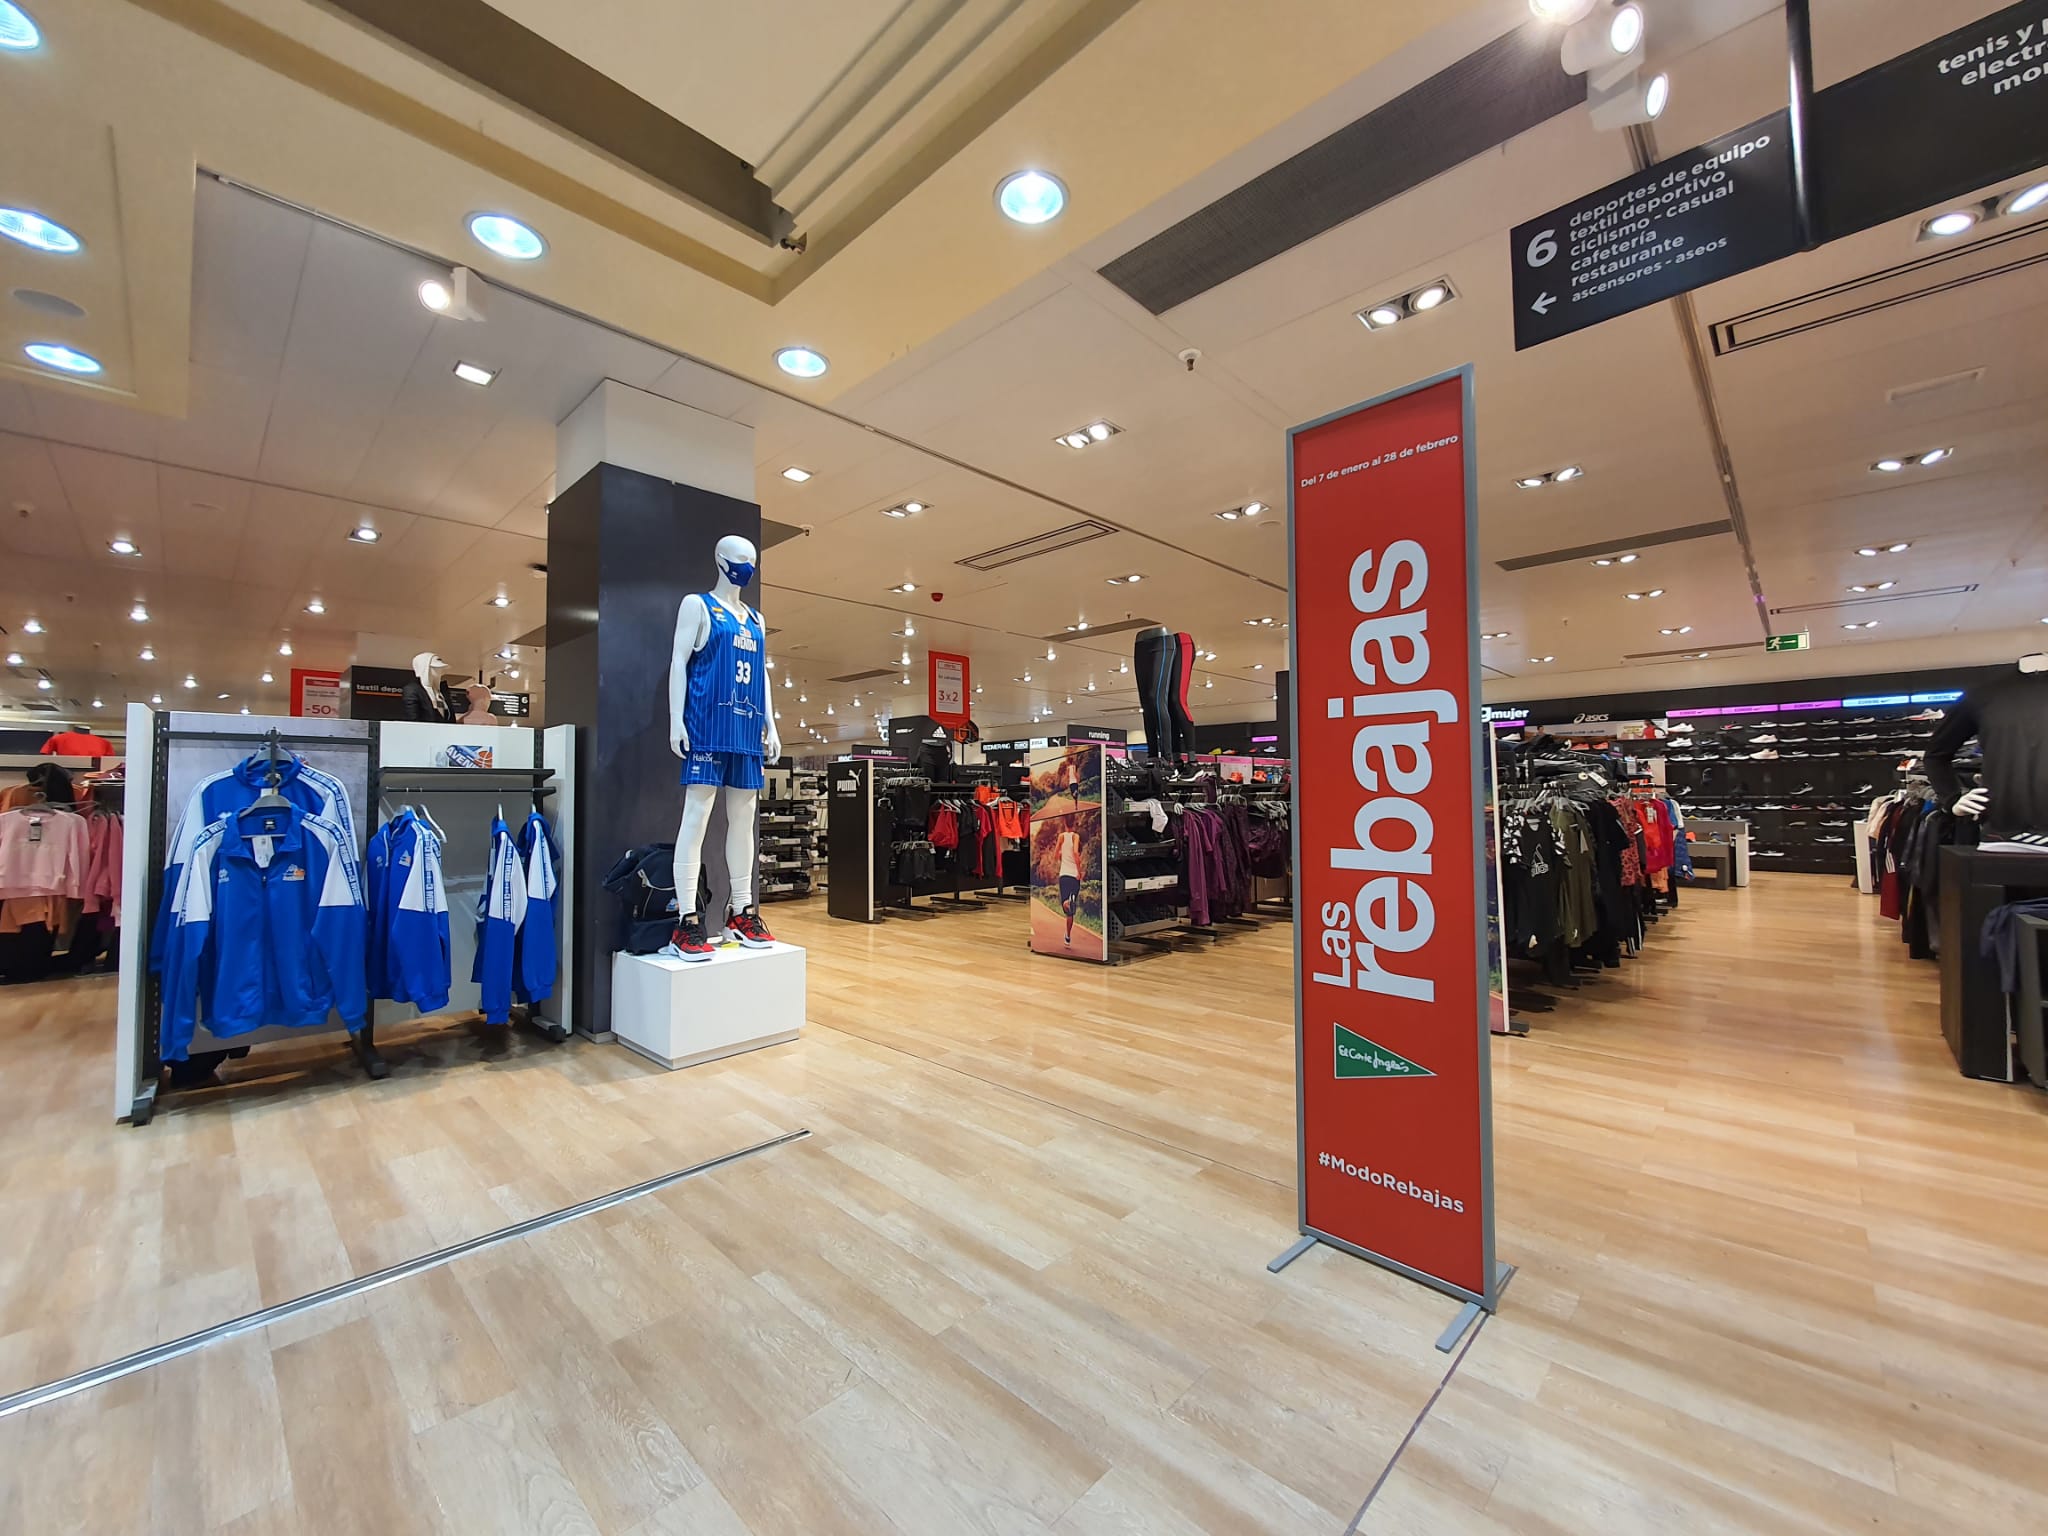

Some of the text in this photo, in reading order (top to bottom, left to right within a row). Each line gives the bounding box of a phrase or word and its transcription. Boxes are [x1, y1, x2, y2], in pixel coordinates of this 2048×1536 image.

[1938, 35, 2010, 74] tenis
[2016, 23, 2034, 46] y
[1961, 41, 2048, 86] electr
[1569, 135, 1770, 227] deportes de equipo
[1569, 171, 1726, 242] textil deportivo
[1570, 217, 1650, 256] ciclismo
[1666, 180, 1734, 217] casual
[1526, 229, 1558, 268] 6
[1570, 229, 1657, 272] cafetería
[1571, 235, 1685, 287] restaurante
[1572, 260, 1662, 302] ascensores
[1675, 236, 1728, 264] aseos
[1301, 434, 1459, 488] Del 7 de enero al 28 de febrero
[356, 684, 403, 693] textil depo
[735, 660, 751, 685] 33
[1088, 730, 1110, 741] running
[1491, 707, 1530, 720] mujer
[1585, 713, 1609, 722] asics
[836, 780, 857, 792] PUMA
[1327, 538, 1460, 1004] rebajas
[1312, 900, 1351, 988] Las
[1348, 1048, 1373, 1064] Corte
[1317, 1150, 1466, 1214] #ModoRebajas
